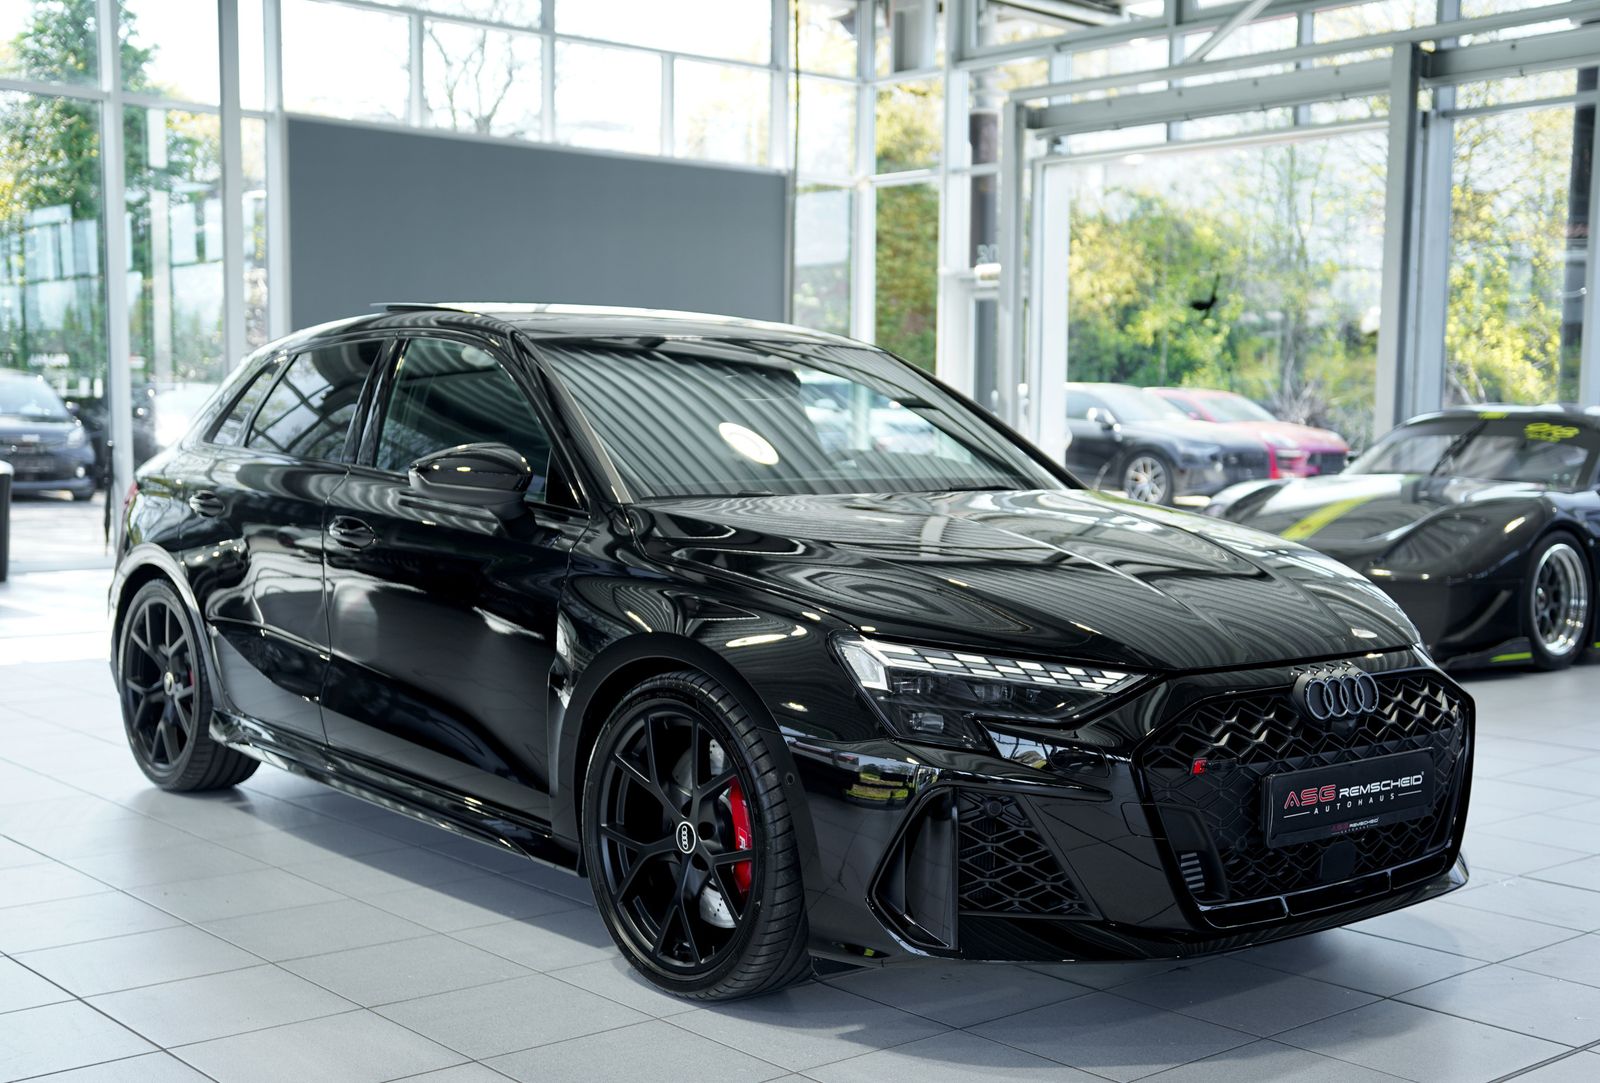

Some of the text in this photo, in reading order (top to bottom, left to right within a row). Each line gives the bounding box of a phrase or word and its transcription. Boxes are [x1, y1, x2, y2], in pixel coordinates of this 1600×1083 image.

[1284, 774, 1423, 810] ASG REMSCHEID
[1314, 792, 1395, 815] AUTOHAUS
